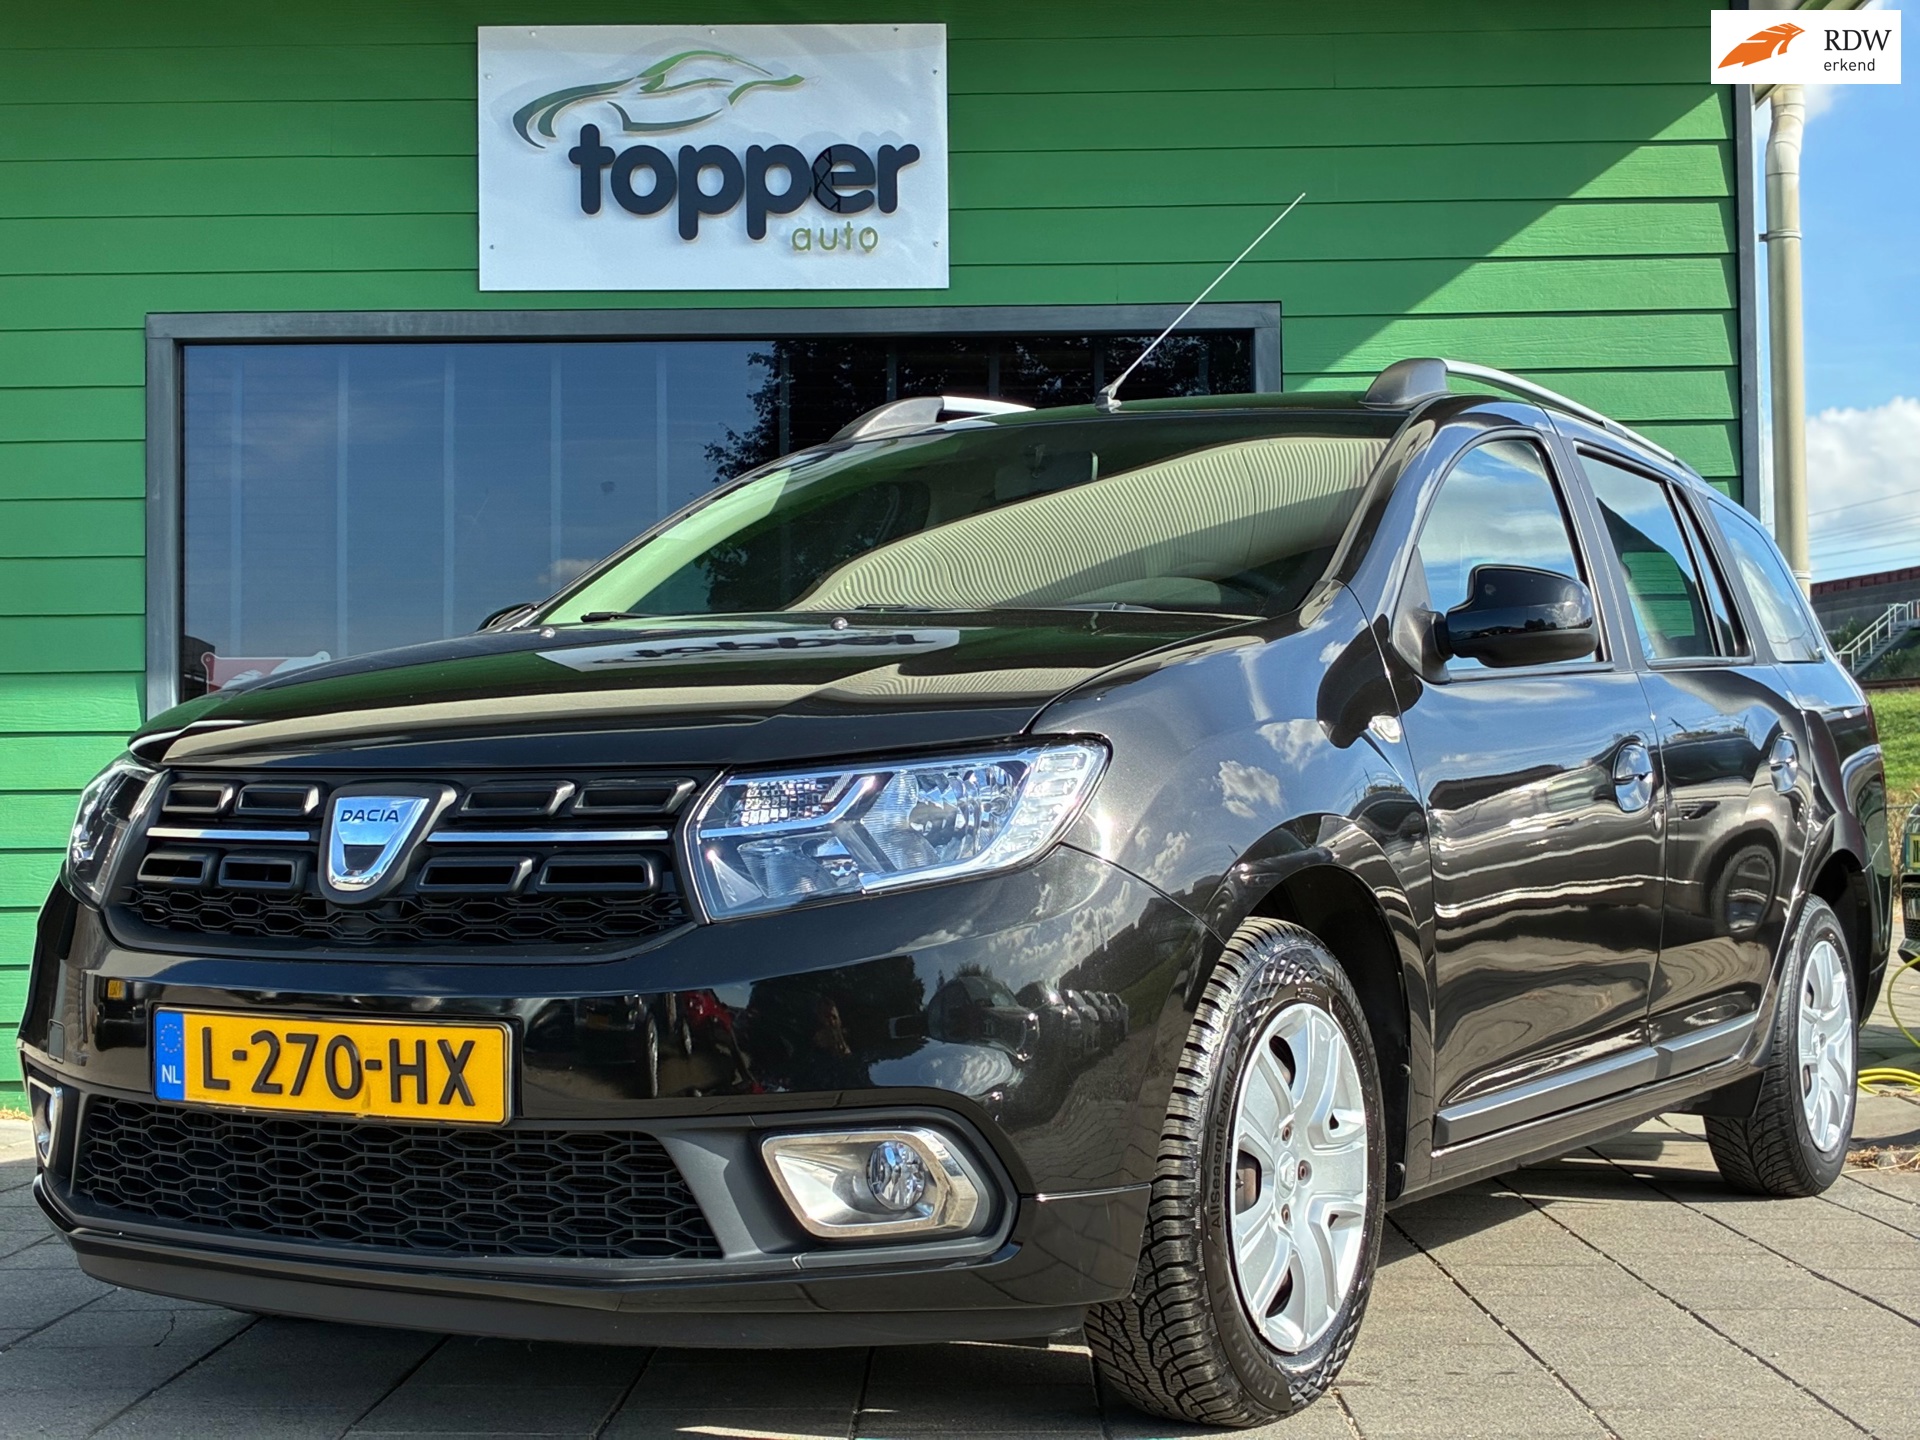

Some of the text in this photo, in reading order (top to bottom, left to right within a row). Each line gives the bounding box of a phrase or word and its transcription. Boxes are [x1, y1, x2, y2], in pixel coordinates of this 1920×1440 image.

[568, 123, 920, 241] topper
[792, 221, 878, 252] auto
[340, 809, 399, 822] DACIA
[161, 1065, 181, 1084] NL
[202, 1026, 476, 1106] L-270-HX
